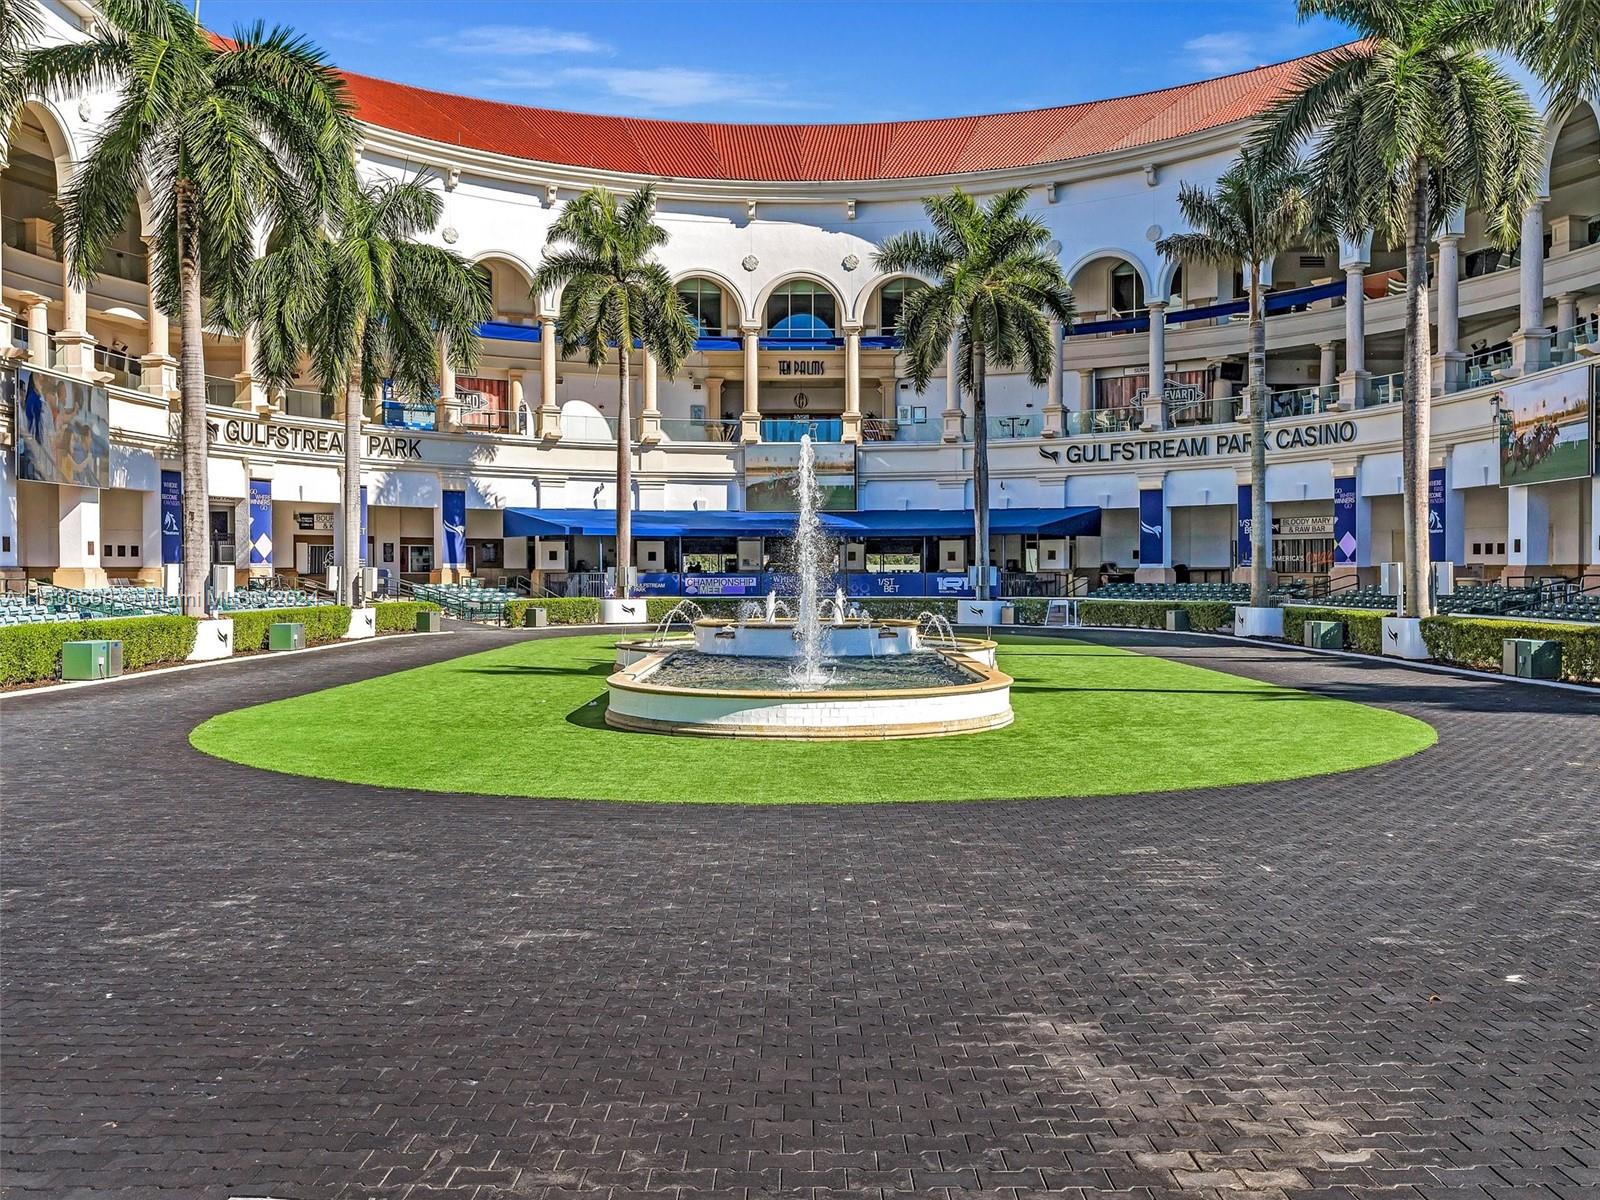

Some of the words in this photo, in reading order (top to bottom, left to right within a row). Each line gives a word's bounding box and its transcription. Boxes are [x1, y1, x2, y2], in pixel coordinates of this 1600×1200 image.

[778, 360, 791, 375] TEN
[794, 360, 824, 375] PALMS
[226, 419, 346, 453] GULFSTREA
[369, 435, 421, 458] PARK
[1066, 437, 1208, 464] GULFSTREAM
[1276, 421, 1355, 450] CASINO
[1283, 518, 1309, 526] BLOODY
[1311, 517, 1331, 525] MARY
[686, 578, 755, 586] CHAMPIONSHIP
[700, 586, 722, 594] MEET
[883, 585, 900, 593] BET
